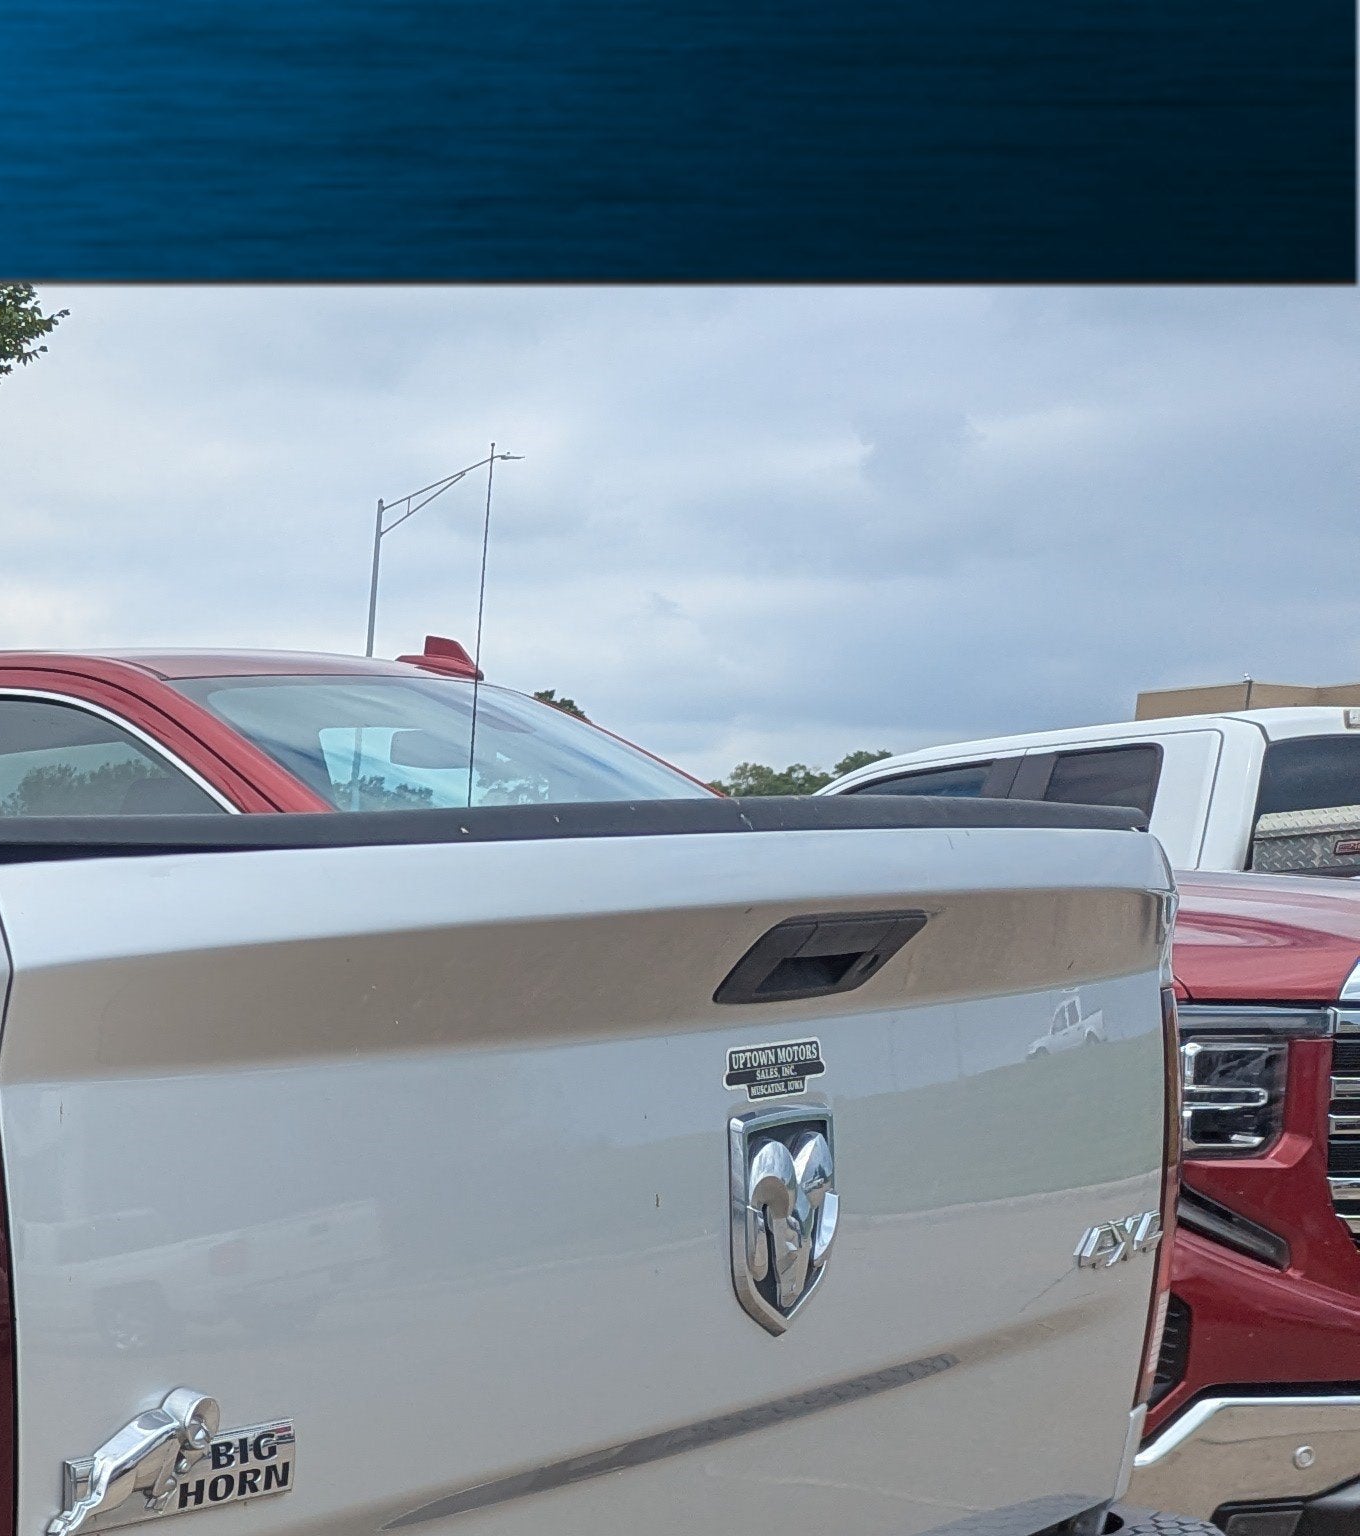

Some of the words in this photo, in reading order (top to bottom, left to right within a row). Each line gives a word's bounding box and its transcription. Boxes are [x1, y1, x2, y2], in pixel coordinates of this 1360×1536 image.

[731, 1048, 776, 1070] UPTOWN
[776, 1043, 818, 1064] MOTORS
[755, 1066, 781, 1081] SALES,
[781, 1064, 798, 1077] INC.
[787, 1079, 804, 1092] IOWA
[209, 1432, 278, 1471] BIG
[177, 1461, 291, 1510] HORN
